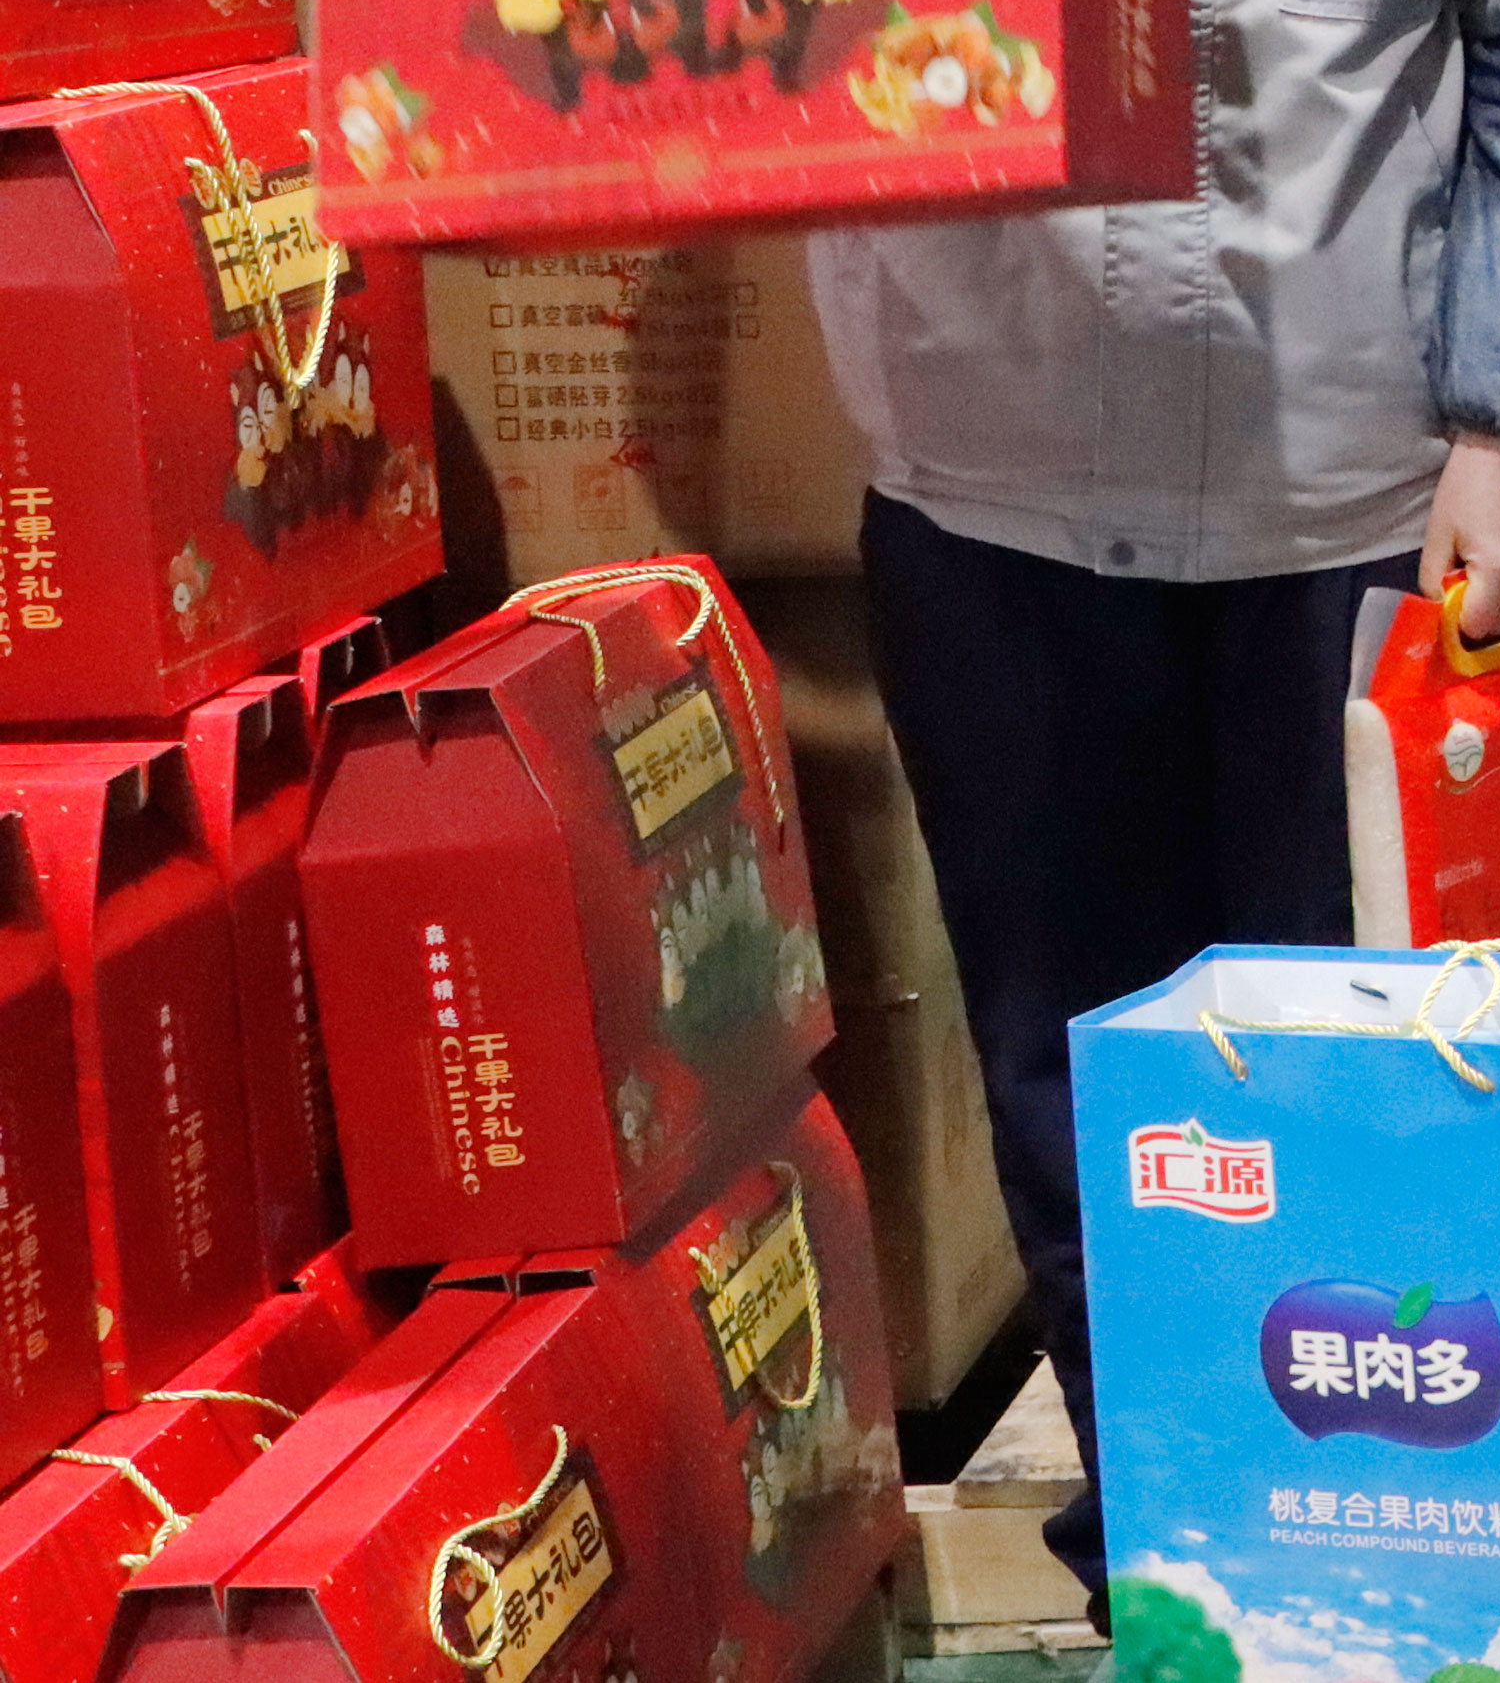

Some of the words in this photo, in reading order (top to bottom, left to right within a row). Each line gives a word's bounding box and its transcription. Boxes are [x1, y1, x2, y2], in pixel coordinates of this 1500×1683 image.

[267, 173, 314, 197] Chines
[213, 216, 320, 287] 干大礼
[9, 486, 63, 630] 干果大礼包
[425, 923, 460, 1028] 森林精选
[440, 1035, 481, 1196] Chinese
[467, 1032, 526, 1168] 干果大礼包
[1135, 1150, 1268, 1198] 汇源
[1288, 1329, 1482, 1407] 果肉多
[1270, 1528, 1327, 1549] PEACH
[1330, 1532, 1430, 1556] COMPOUND
